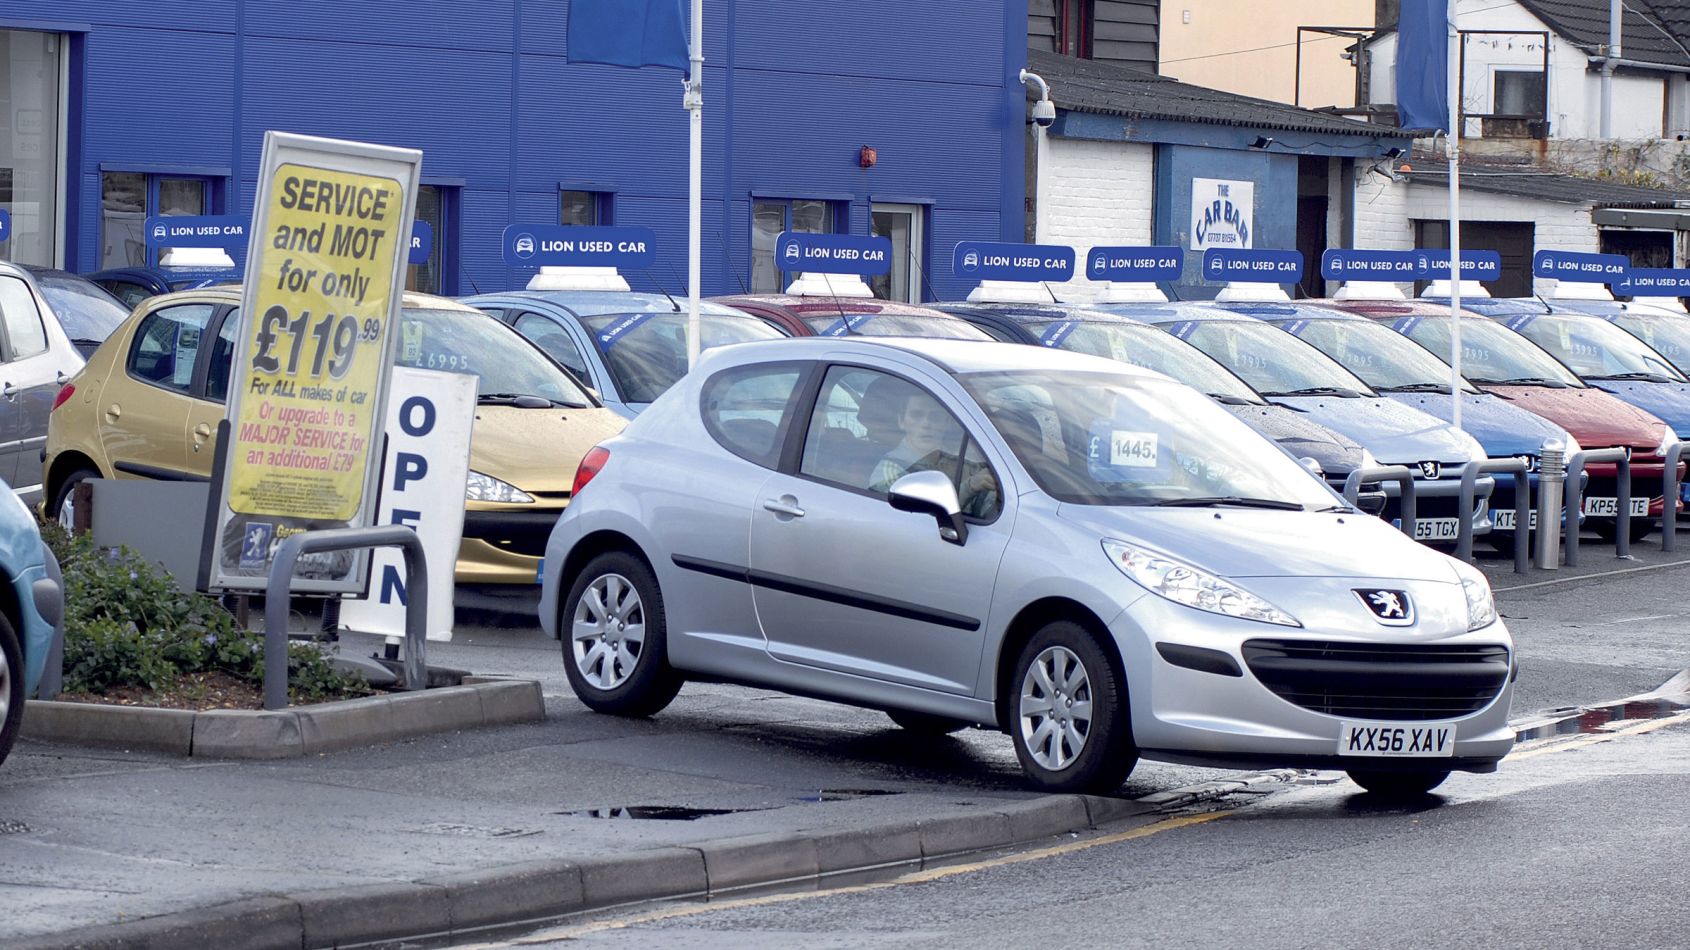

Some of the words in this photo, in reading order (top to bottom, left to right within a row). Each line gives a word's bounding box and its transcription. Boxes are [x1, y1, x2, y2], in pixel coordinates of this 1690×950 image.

[1217, 184, 1230, 197] THE
[1196, 199, 1221, 246] CAR
[1224, 200, 1248, 248] BAR
[171, 227, 194, 236] LION
[197, 226, 221, 236] USED
[223, 226, 243, 235] CAR
[273, 222, 326, 254] and
[329, 224, 386, 261] MOT
[541, 241, 574, 252] LION
[579, 241, 613, 252] USED
[618, 242, 646, 253] CAR
[805, 247, 830, 258] LION
[833, 249, 859, 260] USED
[862, 251, 884, 261] CAR
[983, 256, 1010, 266] LION
[1013, 257, 1041, 268] USED
[1044, 259, 1067, 269] CAR
[1110, 259, 1131, 269] LION
[1134, 258, 1156, 268] USED
[1158, 258, 1177, 268] CAR
[1227, 260, 1249, 270] LION
[1252, 261, 1275, 271] USED
[1278, 262, 1297, 272] CAR
[1347, 261, 1368, 270] LION
[1370, 261, 1393, 271] USED
[1395, 262, 1413, 271] CAR
[1431, 260, 1451, 269] LION
[1459, 261, 1475, 270] SED
[1478, 261, 1496, 270] CAR
[1557, 261, 1579, 271] LION
[1581, 263, 1603, 273] USED
[1605, 265, 1624, 274] CAR
[277, 259, 318, 293] for
[321, 268, 370, 306] only
[1635, 278, 1655, 287] LION
[1656, 278, 1677, 287] USED
[1679, 278, 1690, 287] CA
[250, 377, 270, 395] For
[271, 380, 296, 398] ALL
[300, 384, 333, 402] makes
[336, 386, 348, 402] of
[351, 391, 368, 404] car
[259, 401, 275, 420] Or
[278, 406, 329, 428] upgrade
[334, 409, 345, 426] to
[348, 412, 356, 427] a
[239, 423, 291, 446] MAJOR
[293, 427, 348, 451] SERVICE
[350, 432, 365, 452] for
[1090, 436, 1100, 458] £
[246, 449, 264, 465] an
[267, 448, 332, 471] additional
[1631, 499, 1645, 514] TE
[1435, 521, 1458, 536] TGX
[1349, 727, 1405, 751] KX56
[1408, 728, 1448, 752] XAV
